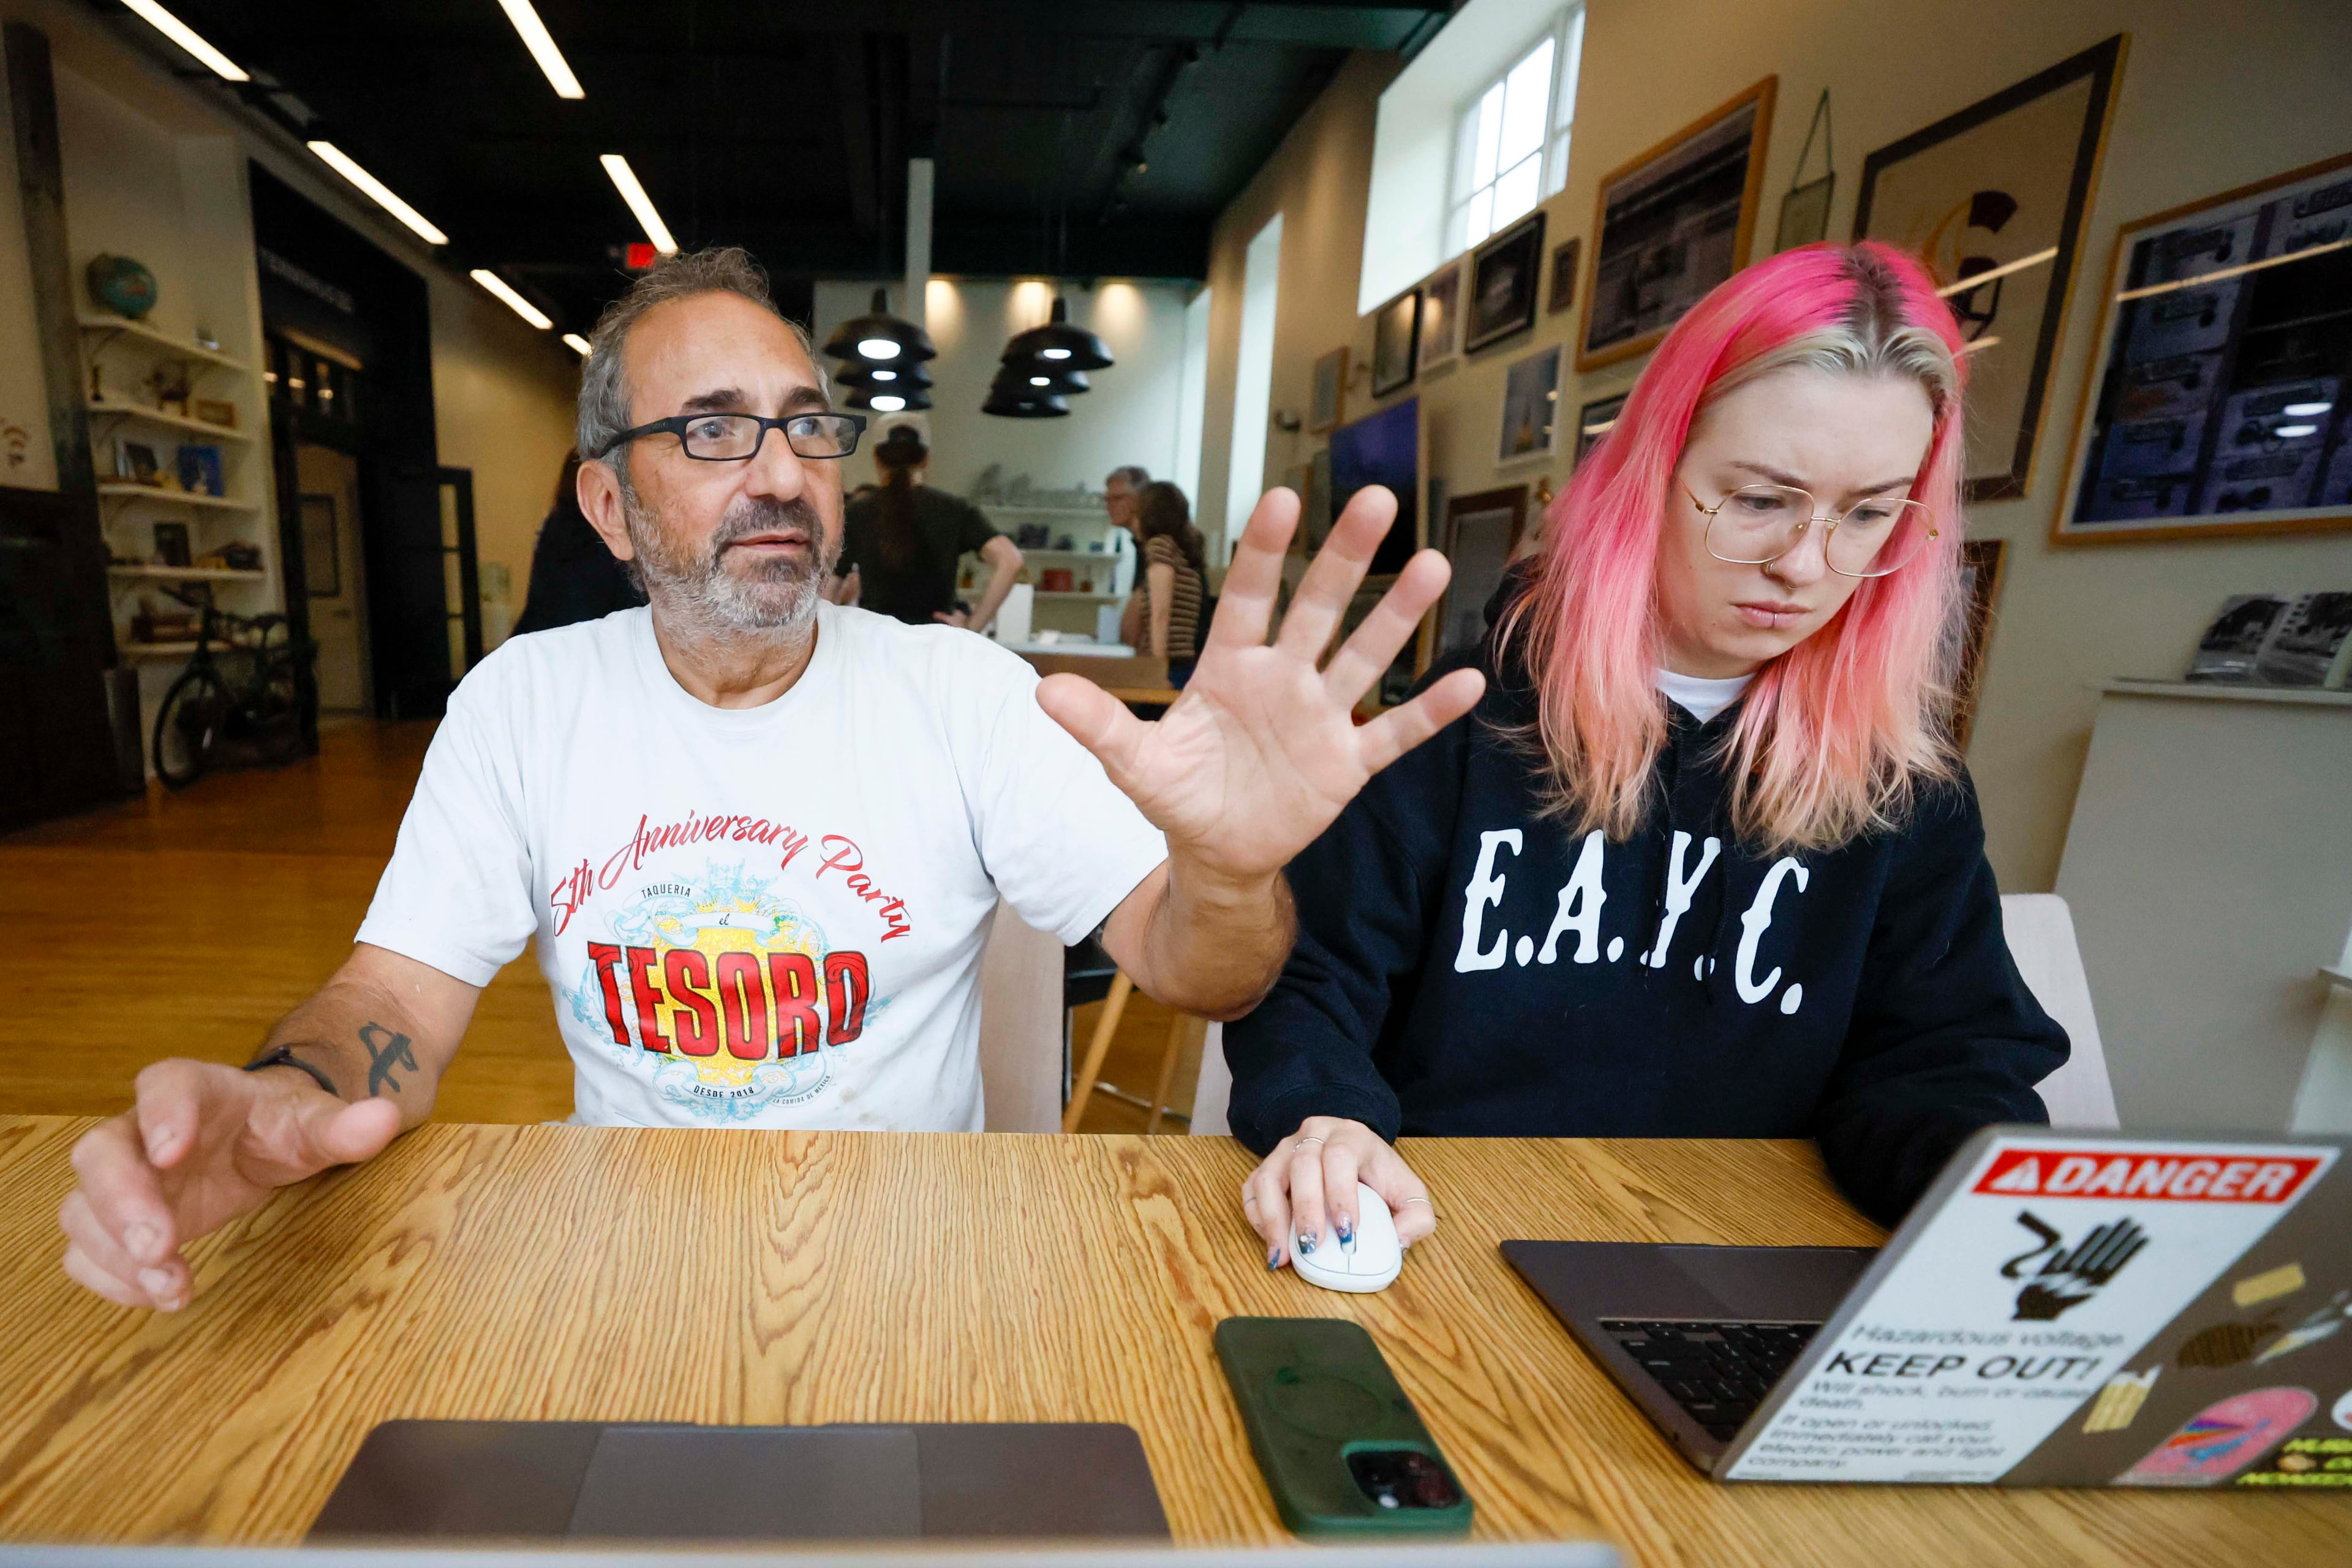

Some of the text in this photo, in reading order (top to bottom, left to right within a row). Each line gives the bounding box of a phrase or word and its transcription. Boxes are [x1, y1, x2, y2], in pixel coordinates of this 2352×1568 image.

[550, 809, 914, 944] 5th Anniversary Party
[641, 883, 691, 899] TAQUERIA
[718, 913, 731, 925] el
[587, 940, 870, 1061] TESORO
[693, 1085, 755, 1098] DESDE 2018
[782, 1096, 804, 1105] COMIDA
[814, 1075, 831, 1094] MEXICO
[2044, 1156, 2297, 1197] DANGER
[1850, 1324, 2125, 1349] Hazardous voltage
[1825, 1351, 2103, 1381] KEEP OUT!
